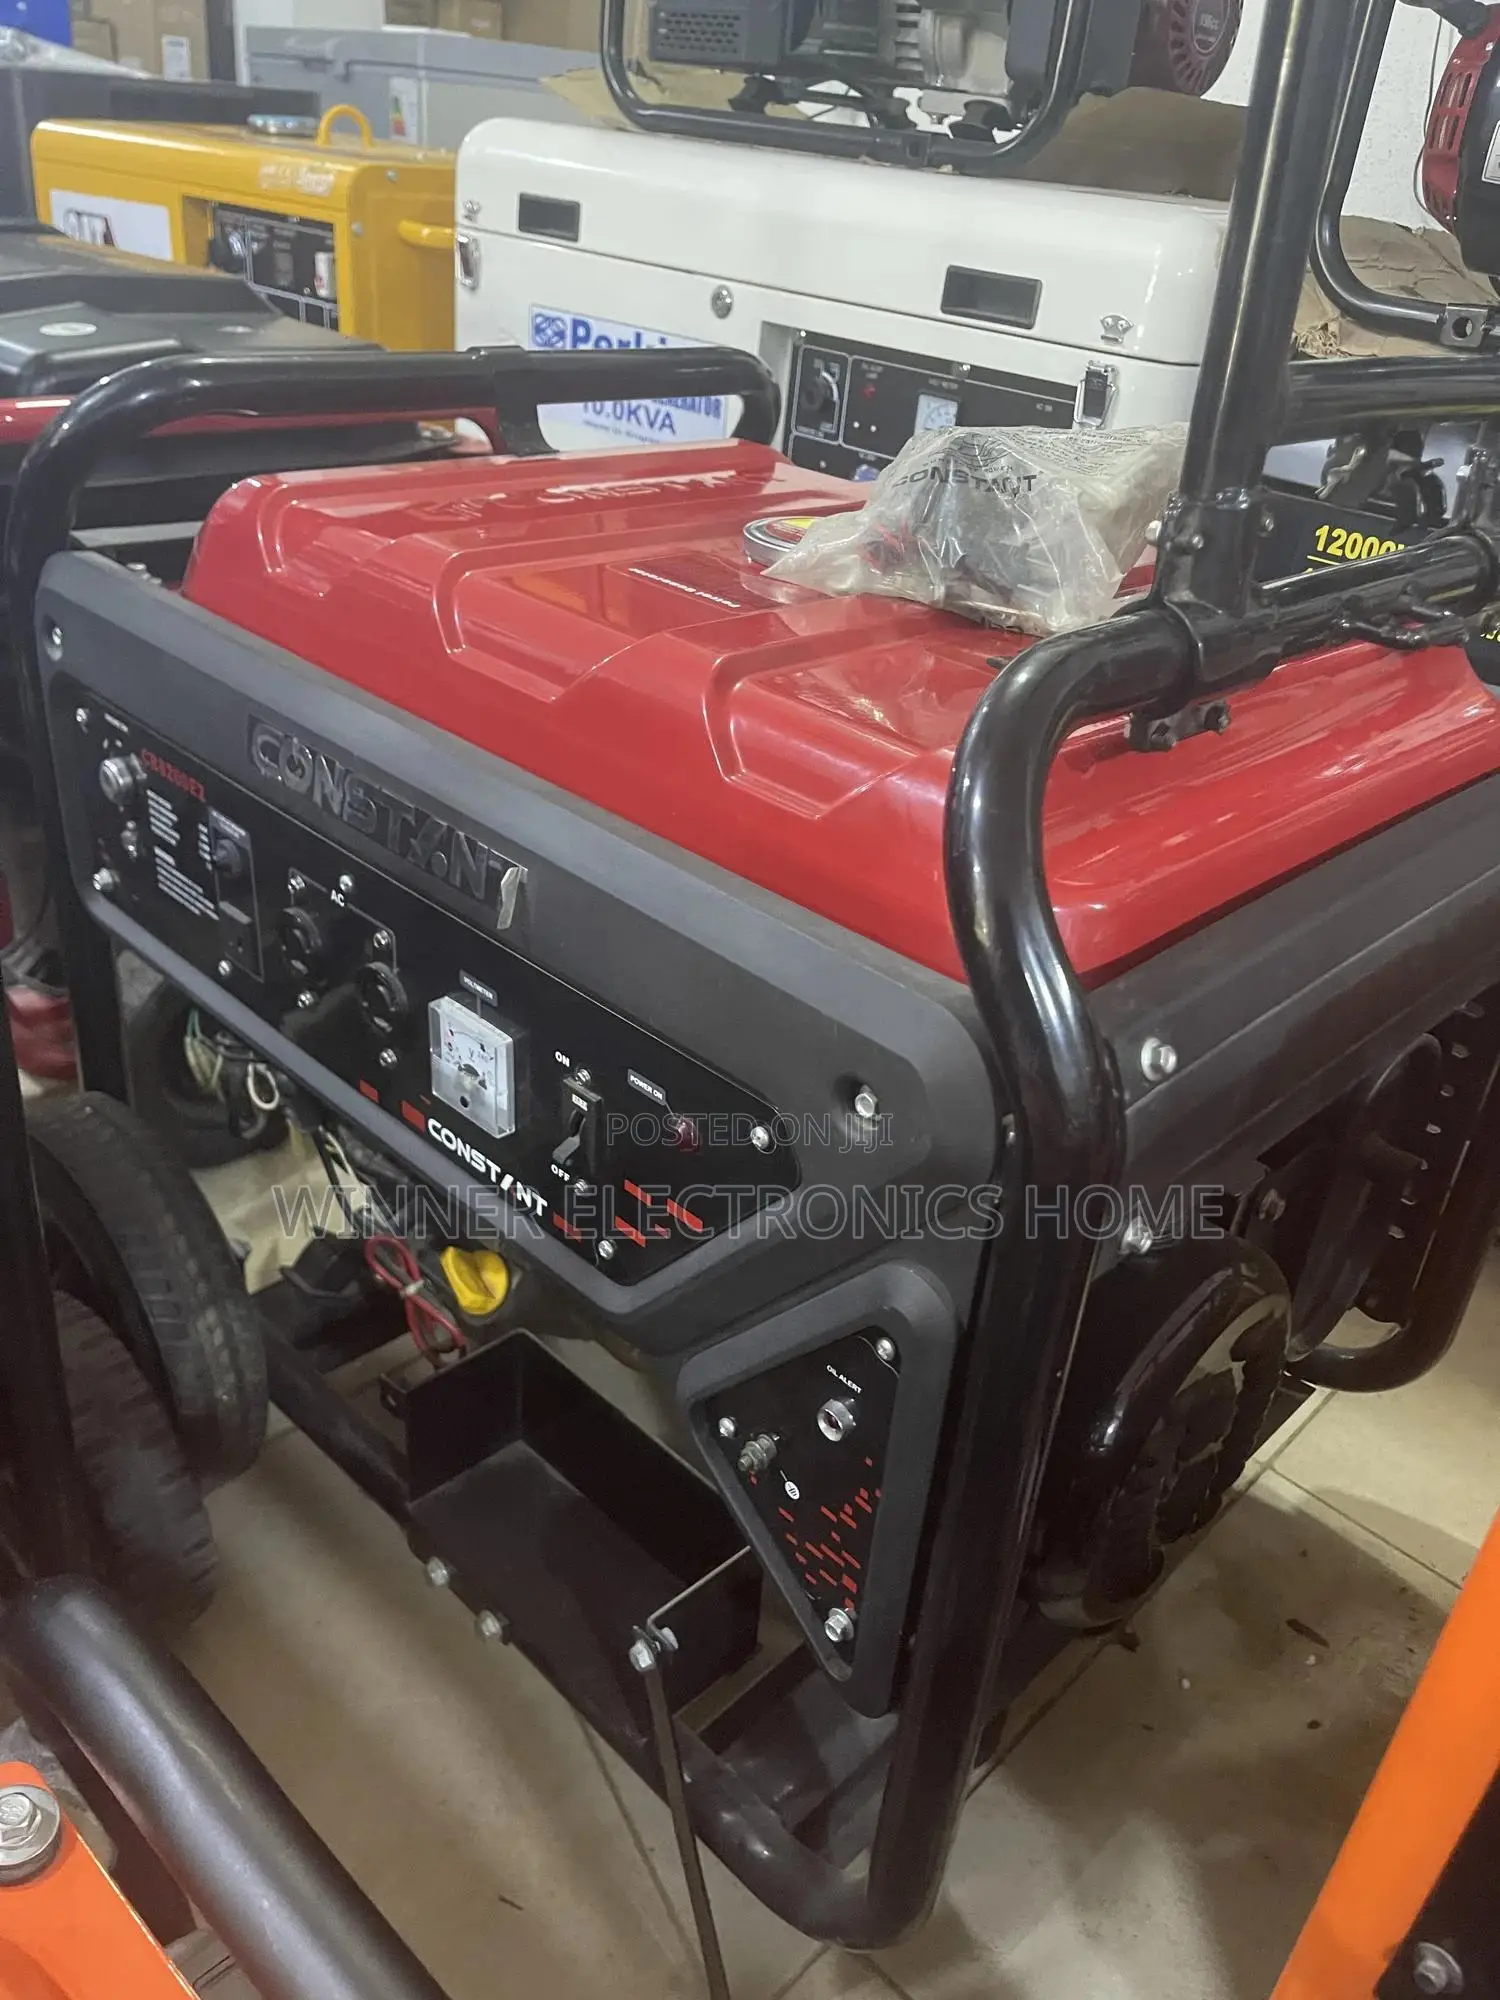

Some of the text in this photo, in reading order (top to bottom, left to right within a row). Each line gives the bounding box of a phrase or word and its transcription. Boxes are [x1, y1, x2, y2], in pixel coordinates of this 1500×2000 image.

[1315, 524, 1405, 561] 1200
[330, 888, 345, 908] AC
[554, 1050, 570, 1068] ON
[629, 1074, 663, 1101] POWER ON
[427, 1117, 548, 1217] CONSTANT
[550, 1163, 571, 1182] OFF
[825, 1363, 862, 1394] OIL ALERT
